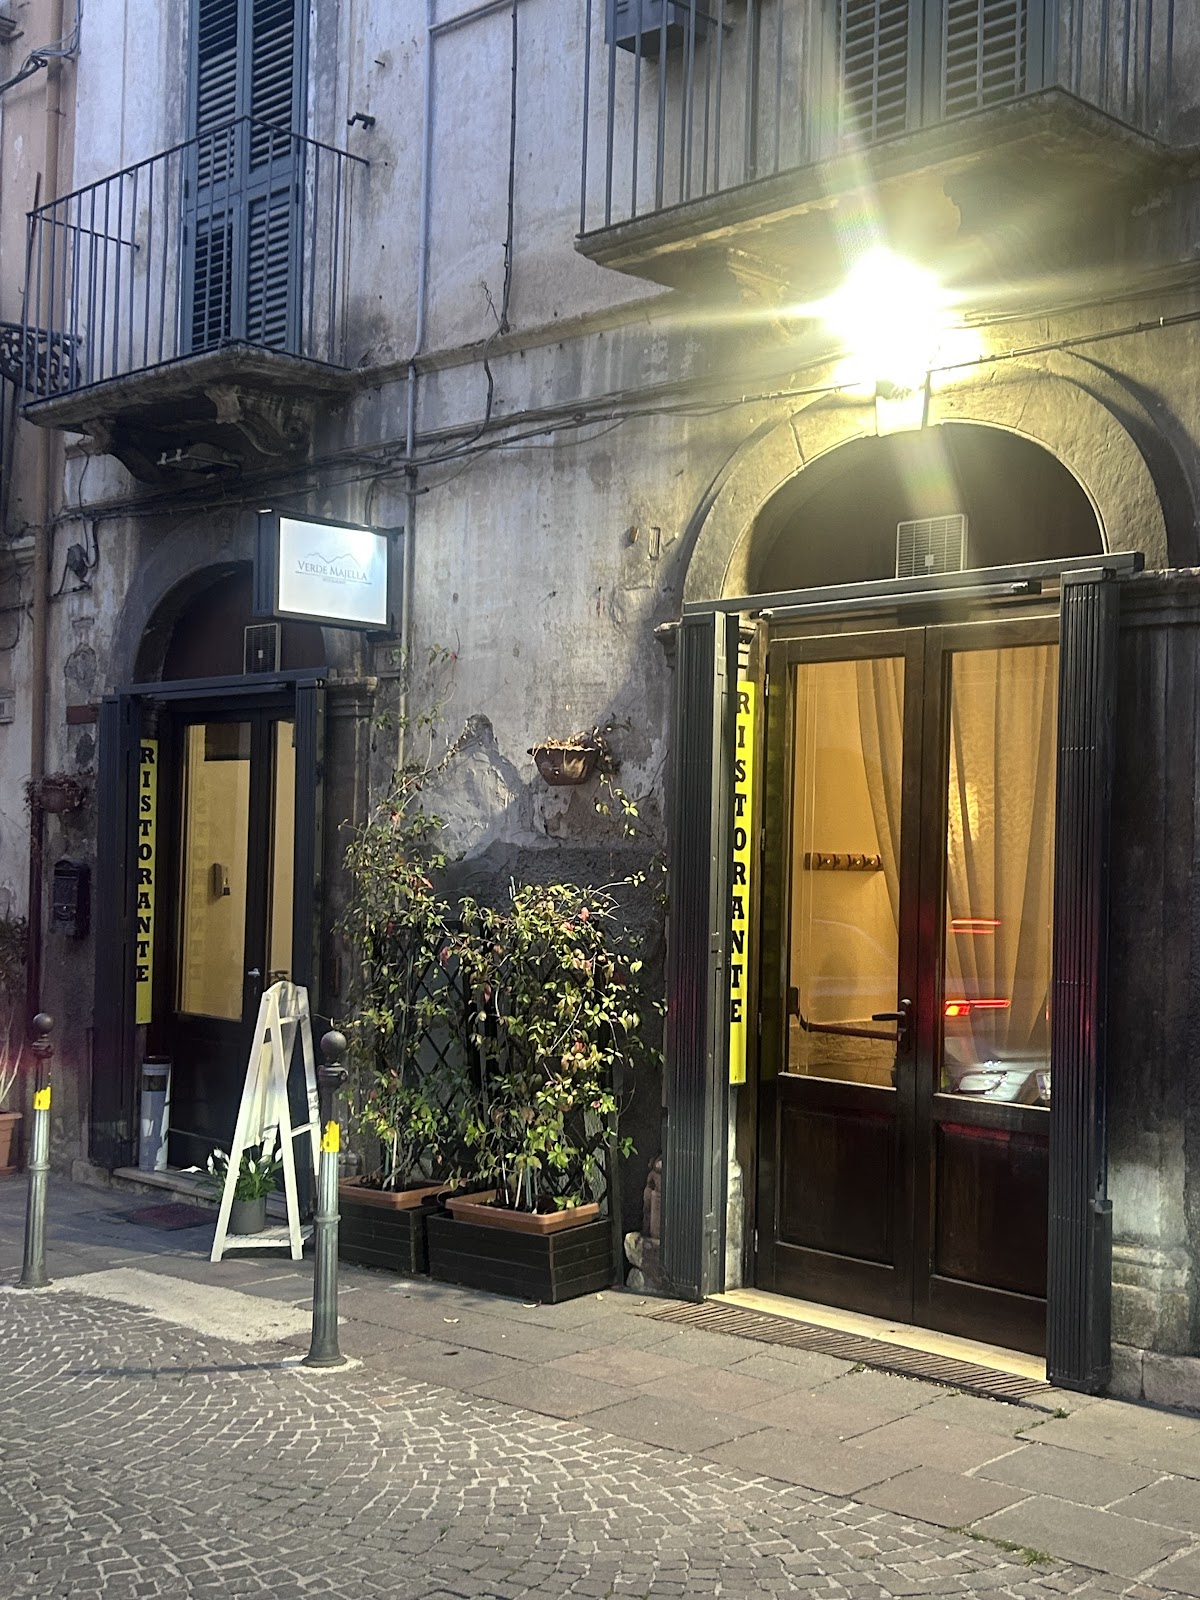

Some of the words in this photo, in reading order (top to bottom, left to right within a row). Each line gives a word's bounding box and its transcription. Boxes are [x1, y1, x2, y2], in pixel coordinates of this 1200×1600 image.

[297, 560, 327, 575] VERDE
[329, 566, 367, 581] MAJELLA
[135, 746, 155, 982] RISTORANTE
[730, 691, 750, 1023] RISTORANTE
